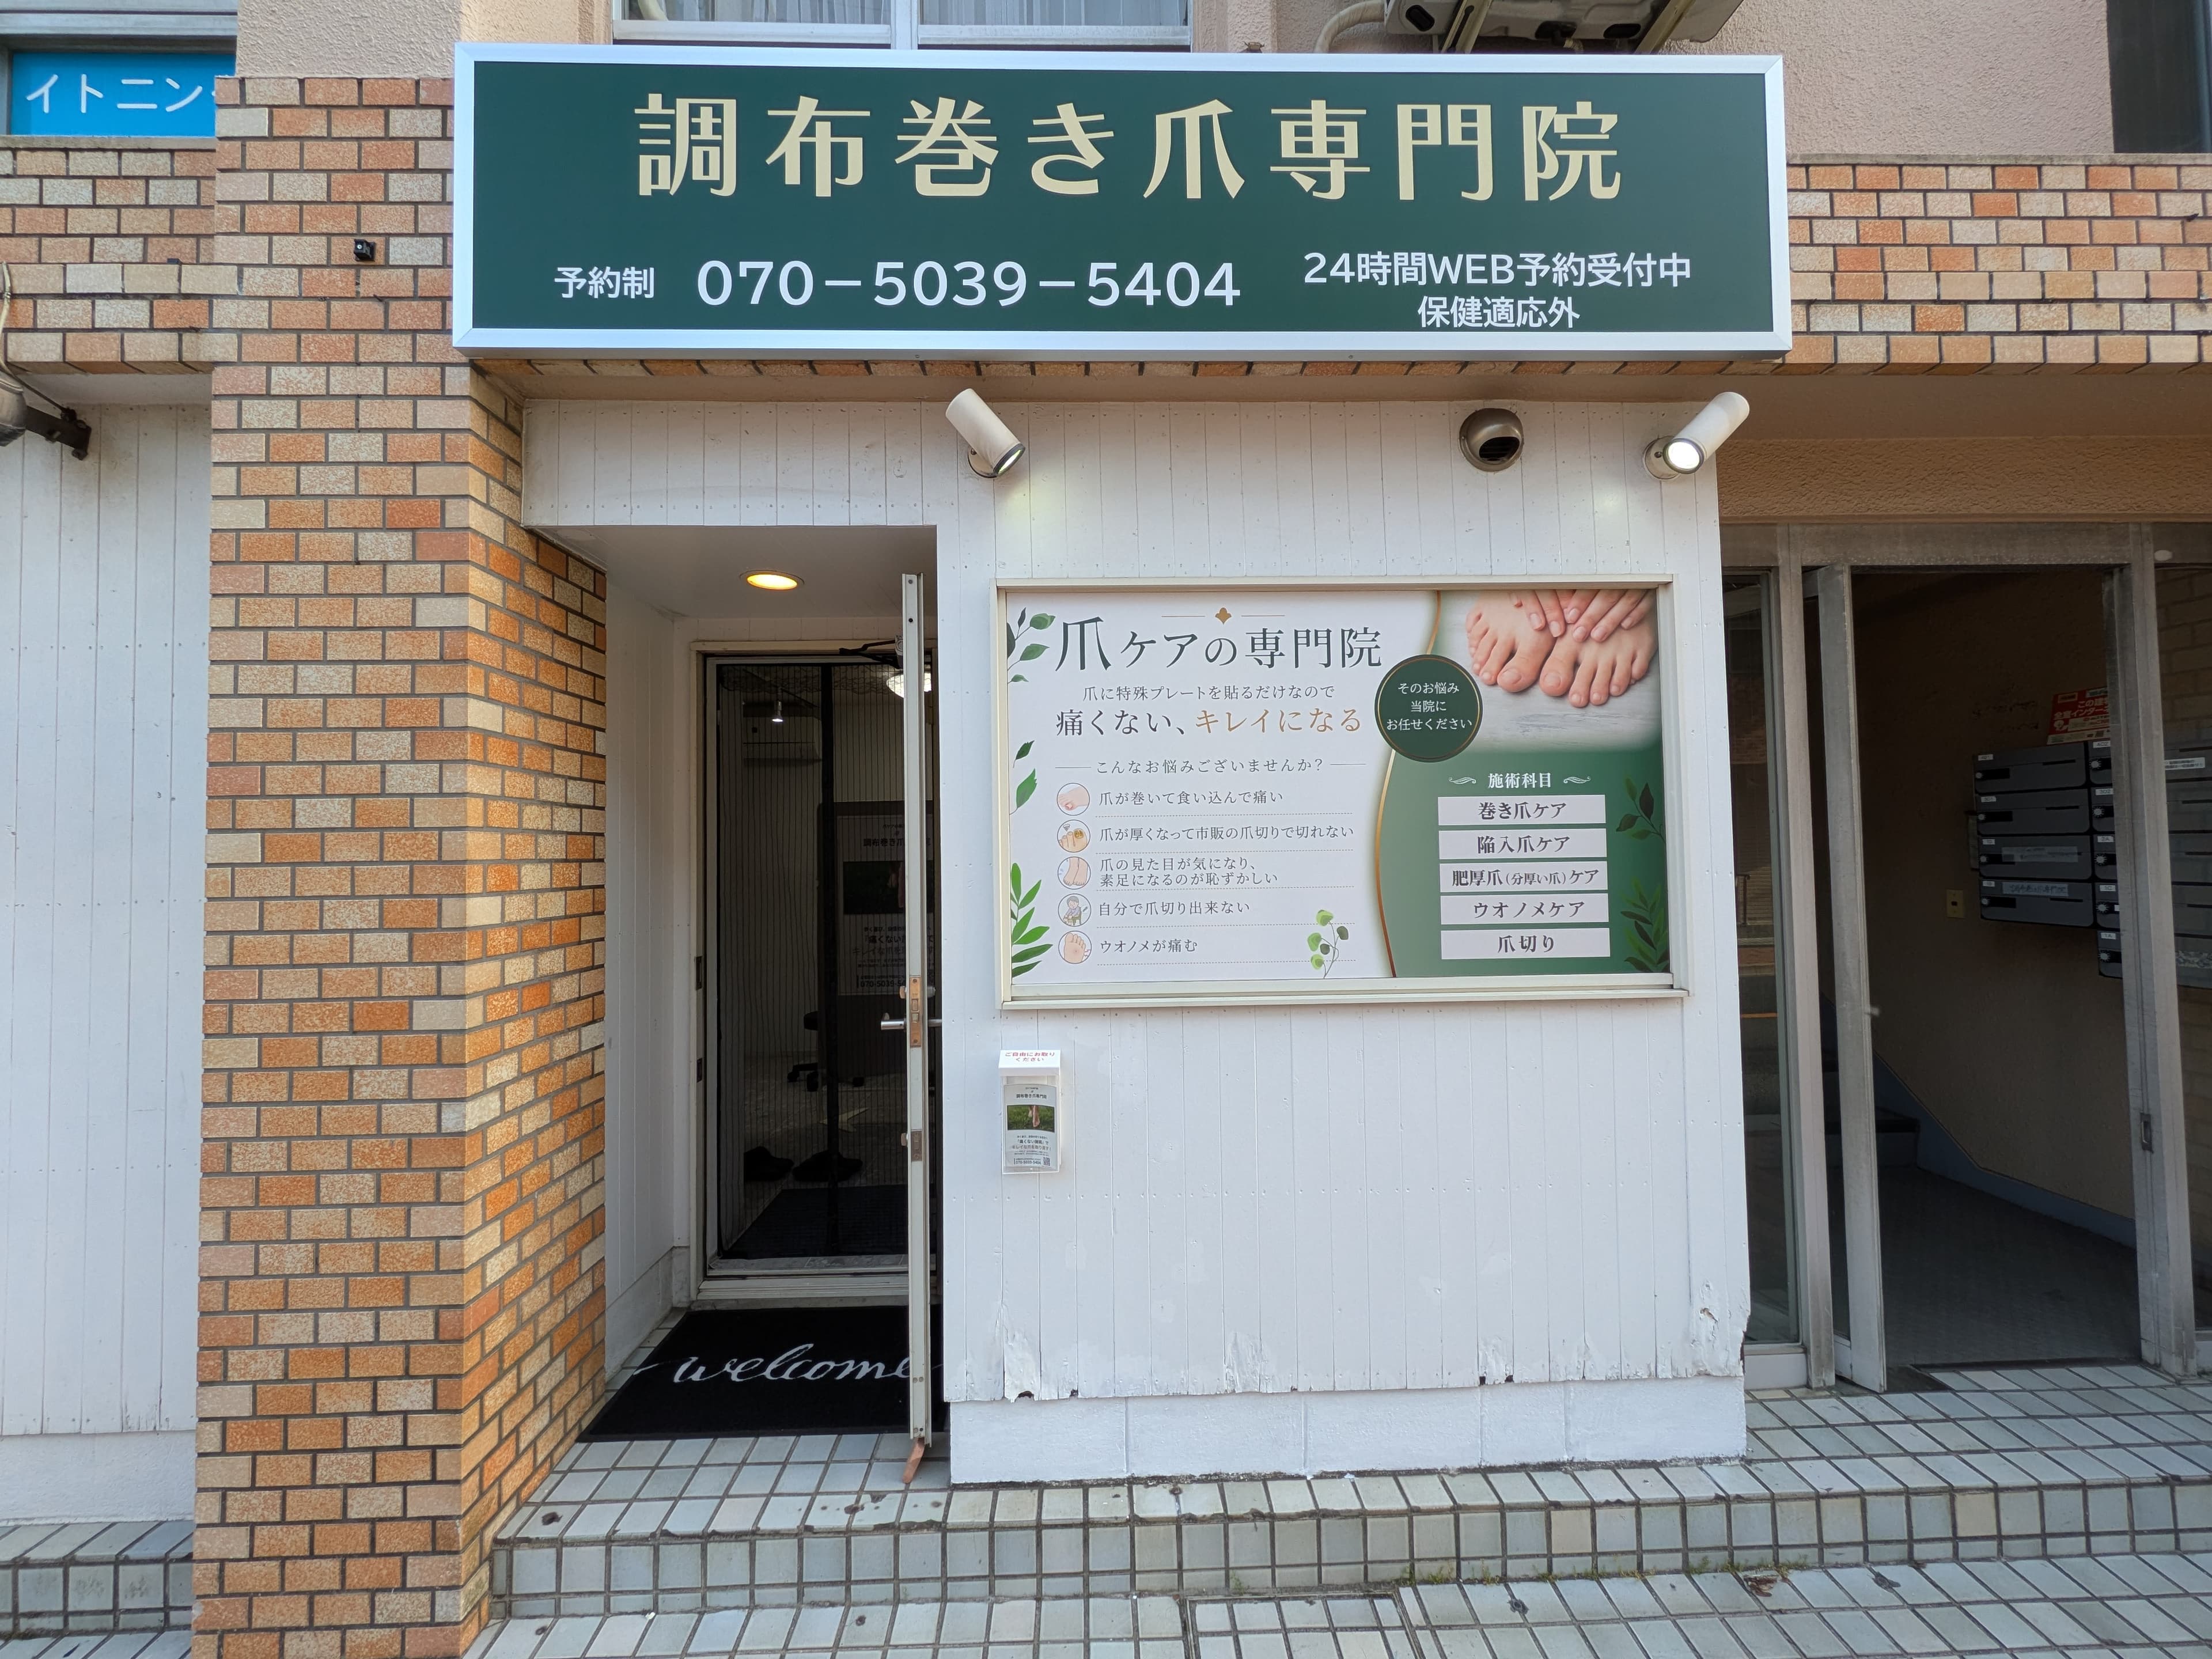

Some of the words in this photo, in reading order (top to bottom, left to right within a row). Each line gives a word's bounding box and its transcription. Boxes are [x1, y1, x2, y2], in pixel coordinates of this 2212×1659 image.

[26, 74, 215, 113] イトニン
[634, 93, 1620, 201] 調布巻き爪専門院
[1304, 251, 1691, 287] 24時間WEB予約受付中
[554, 266, 654, 299] 予約制
[1418, 296, 1580, 328] 保健適応外
[1055, 616, 1382, 672] 爪ケアの専門院
[1082, 685, 1335, 701] 爪に特殊プレートを貼るだけなので
[1397, 681, 1460, 695] そのお悩み
[1410, 700, 1447, 713] 当院に
[1055, 708, 1361, 736] 痛くない、キレイになる
[1386, 718, 1472, 732] お任せください
[1096, 758, 1323, 774] こんなお悩みございませんか？
[1488, 772, 1552, 789] 施術科目
[1099, 790, 1283, 806] 爪が巻いて食い込んで痛い
[1478, 801, 1567, 820] 巻き爪ケア
[1099, 825, 1354, 842] 爪が厚くなって市販の爪切りで切れない
[1477, 835, 1570, 854] 陥入爪ケア
[1100, 857, 1256, 871] 爪の見た目が気になり、
[1100, 872, 1278, 887] 素足になるのが恥ずかしい
[1099, 900, 1250, 916] 自分で爪切り出来ない
[1474, 901, 1585, 918] ウオノメケア
[1100, 938, 1198, 953] ウオノメが痛む
[1497, 934, 1555, 954] 爪切り
